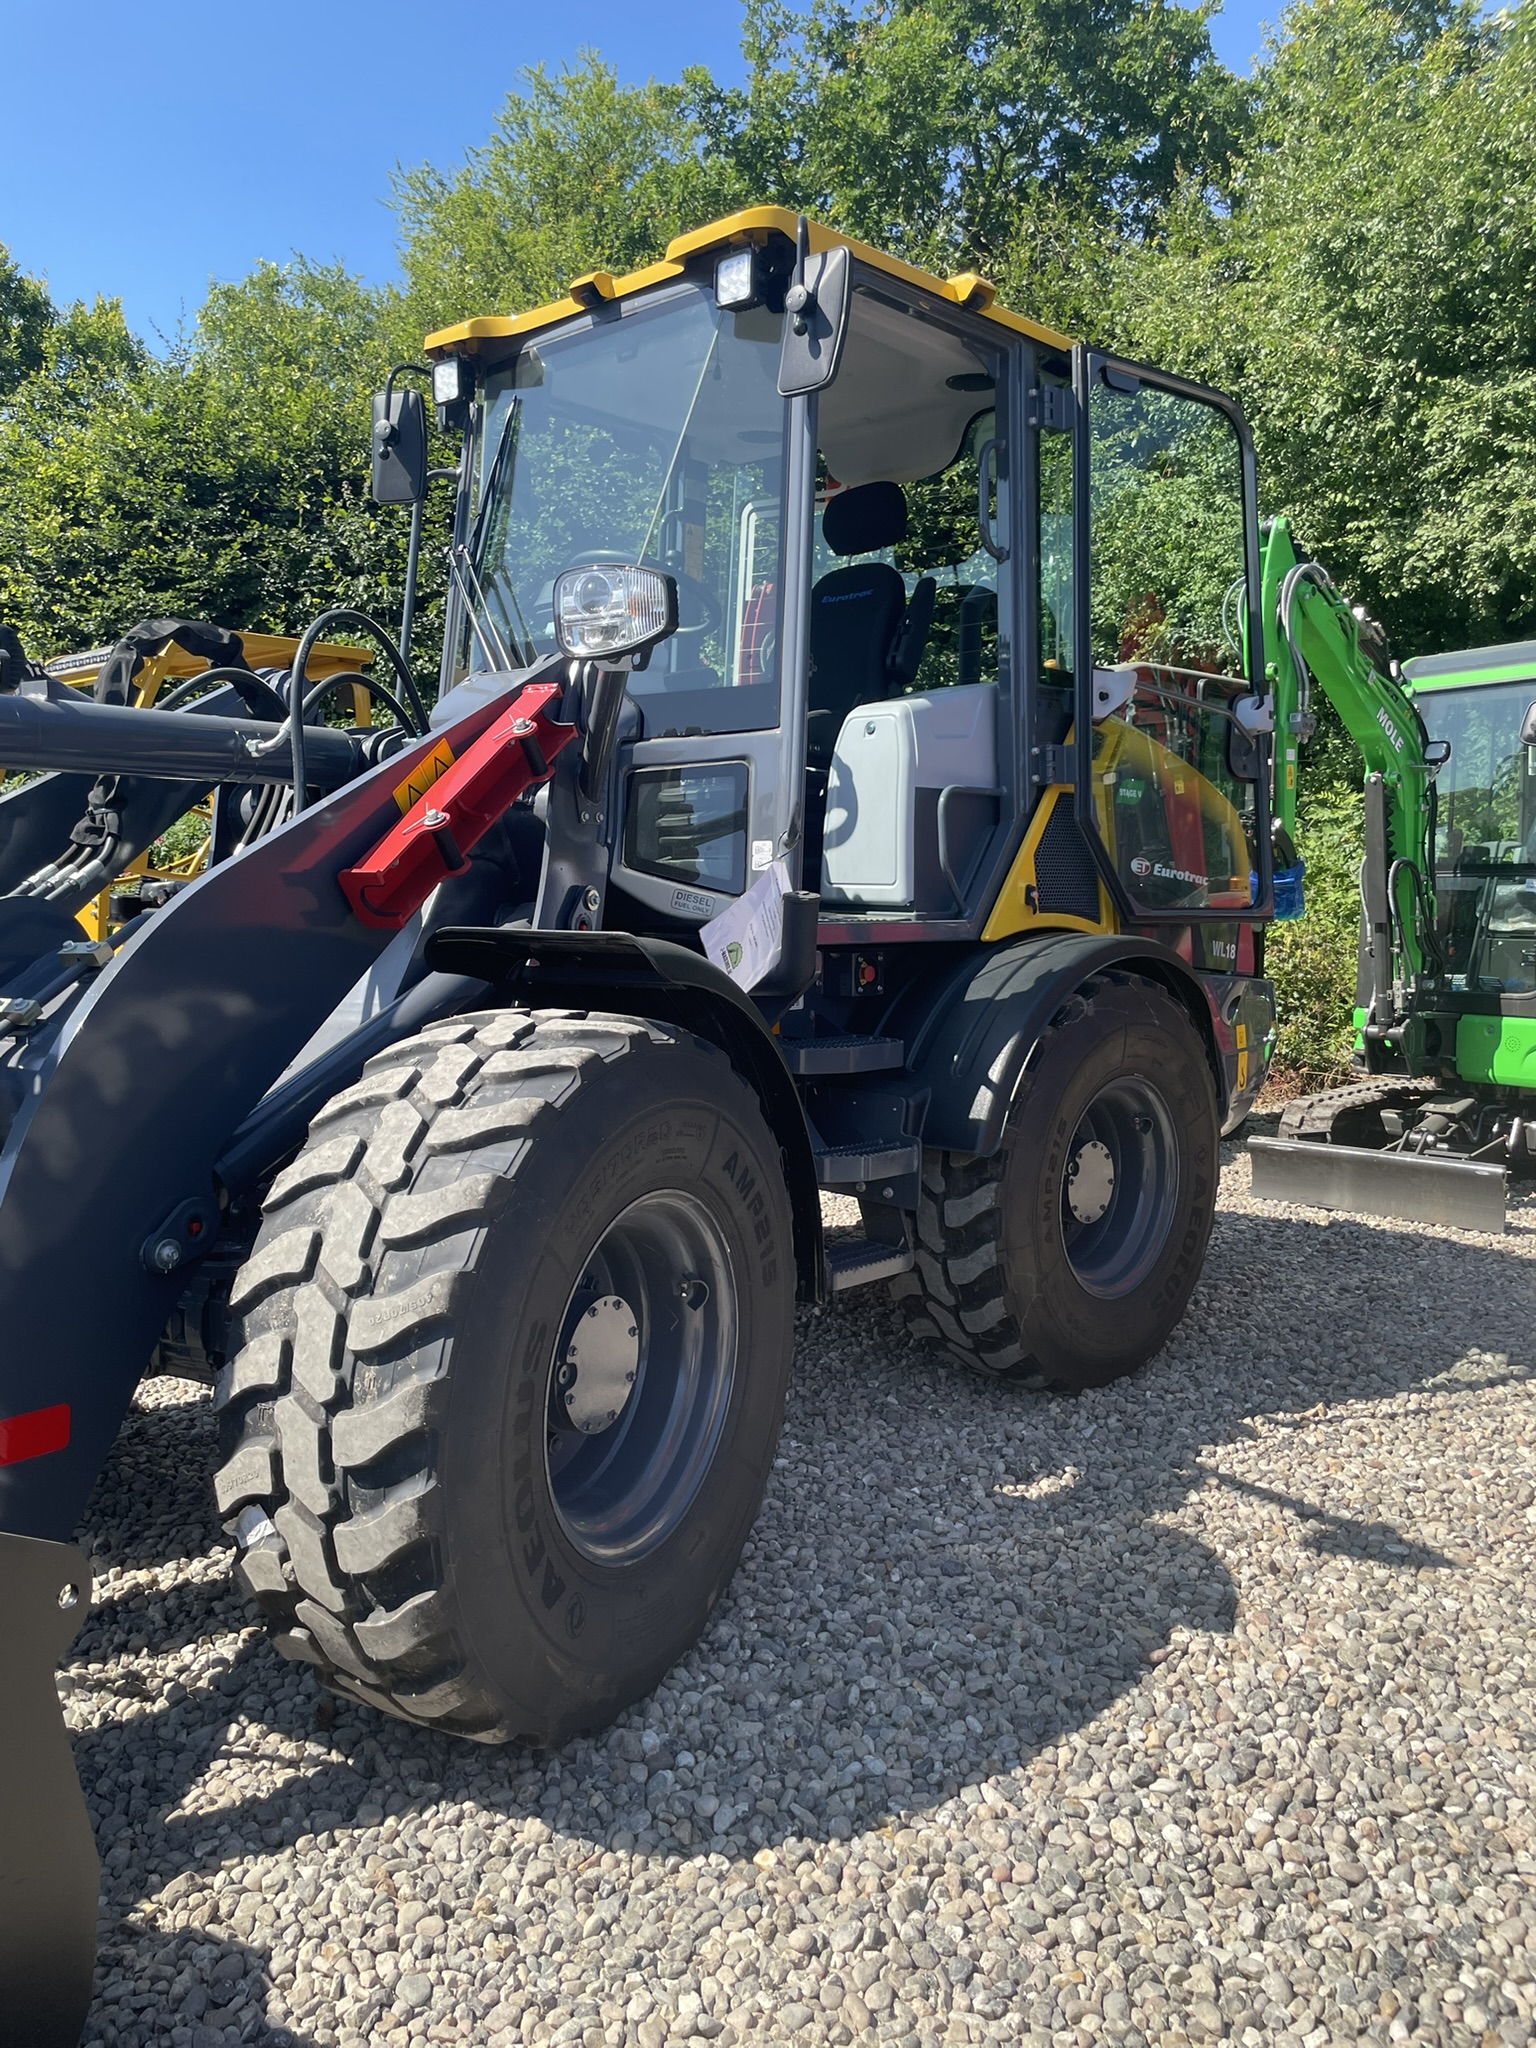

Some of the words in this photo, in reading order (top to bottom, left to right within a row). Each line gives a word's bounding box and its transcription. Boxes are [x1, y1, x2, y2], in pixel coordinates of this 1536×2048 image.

[822, 589, 874, 603] Eurotrac
[1376, 706, 1404, 754] MOLE
[1119, 788, 1137, 799] STAGE
[1153, 863, 1210, 886] Eurotrac
[674, 900, 691, 910] FUEL
[692, 905, 711, 914] ONLY
[675, 891, 711, 907] DIESEL
[1212, 940, 1237, 960] WL18
[1043, 1116, 1068, 1243] AMP215
[721, 1150, 777, 1289] AMP215
[1150, 1172, 1208, 1315] AEOLUS
[513, 1319, 567, 1611] AEOLUS
